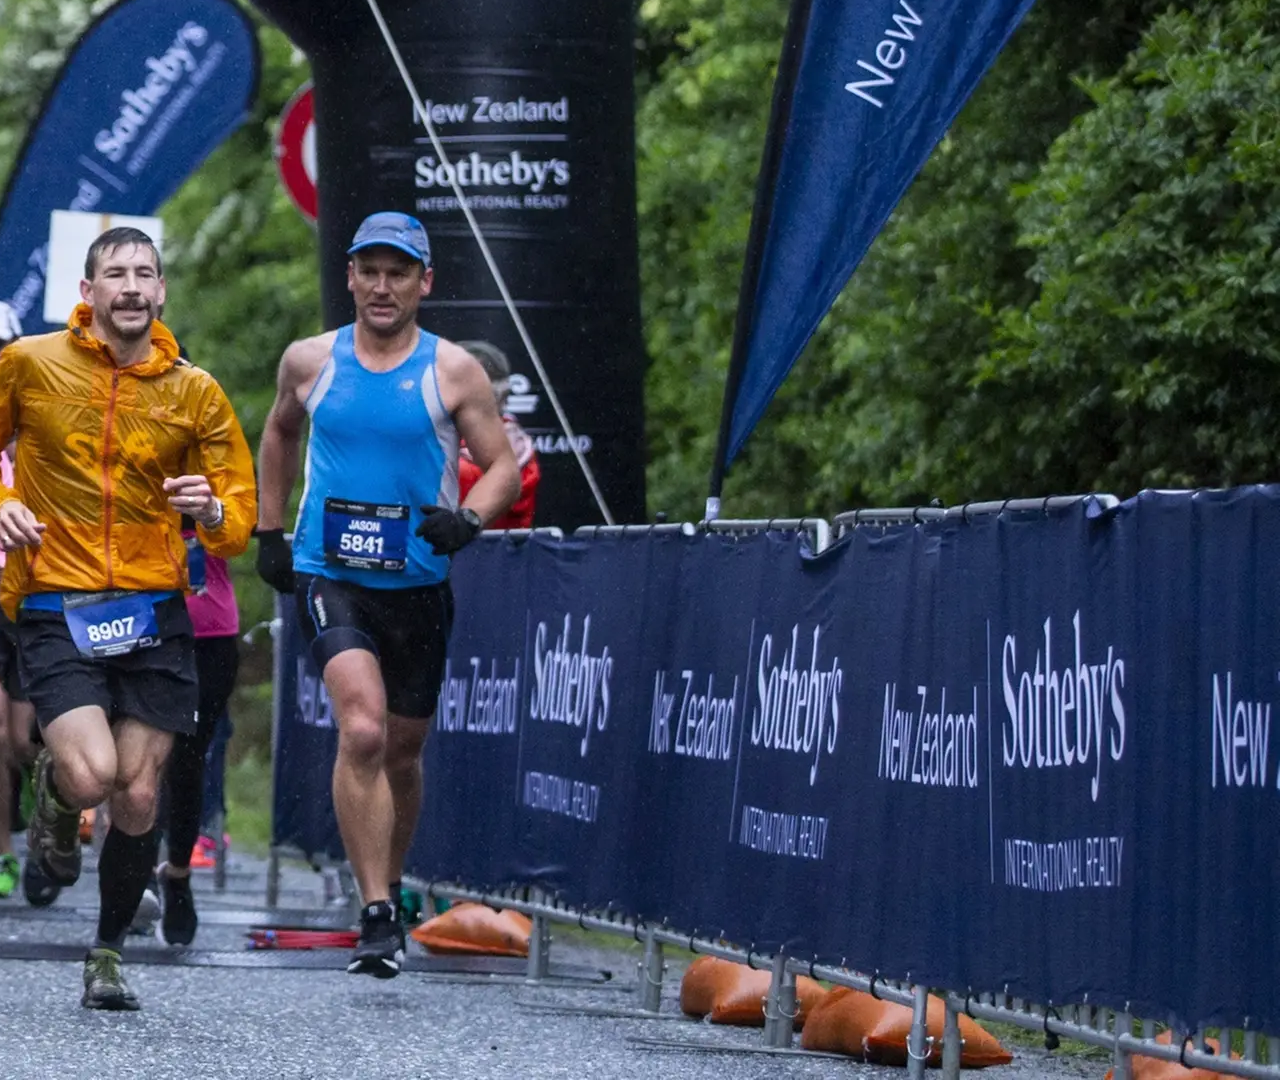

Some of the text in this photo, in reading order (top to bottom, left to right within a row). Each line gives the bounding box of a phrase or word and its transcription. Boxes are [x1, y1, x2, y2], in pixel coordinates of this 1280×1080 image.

[413, 96, 570, 125] New Zealand
[414, 150, 571, 194] Sotheby's
[340, 533, 385, 554] 5841
[348, 519, 381, 533] JASON
[87, 616, 135, 643] 8907
[467, 656, 520, 735] Zealand
[530, 612, 613, 758] Sotheby's
[675, 669, 739, 761] Zealand
[750, 623, 842, 787] Sotheby's
[1002, 608, 1126, 802] Sotheby's
[878, 682, 978, 788] New Zealand
[1212, 671, 1271, 789] New
[1004, 837, 1125, 892] INTERNATIONAL REALTY
